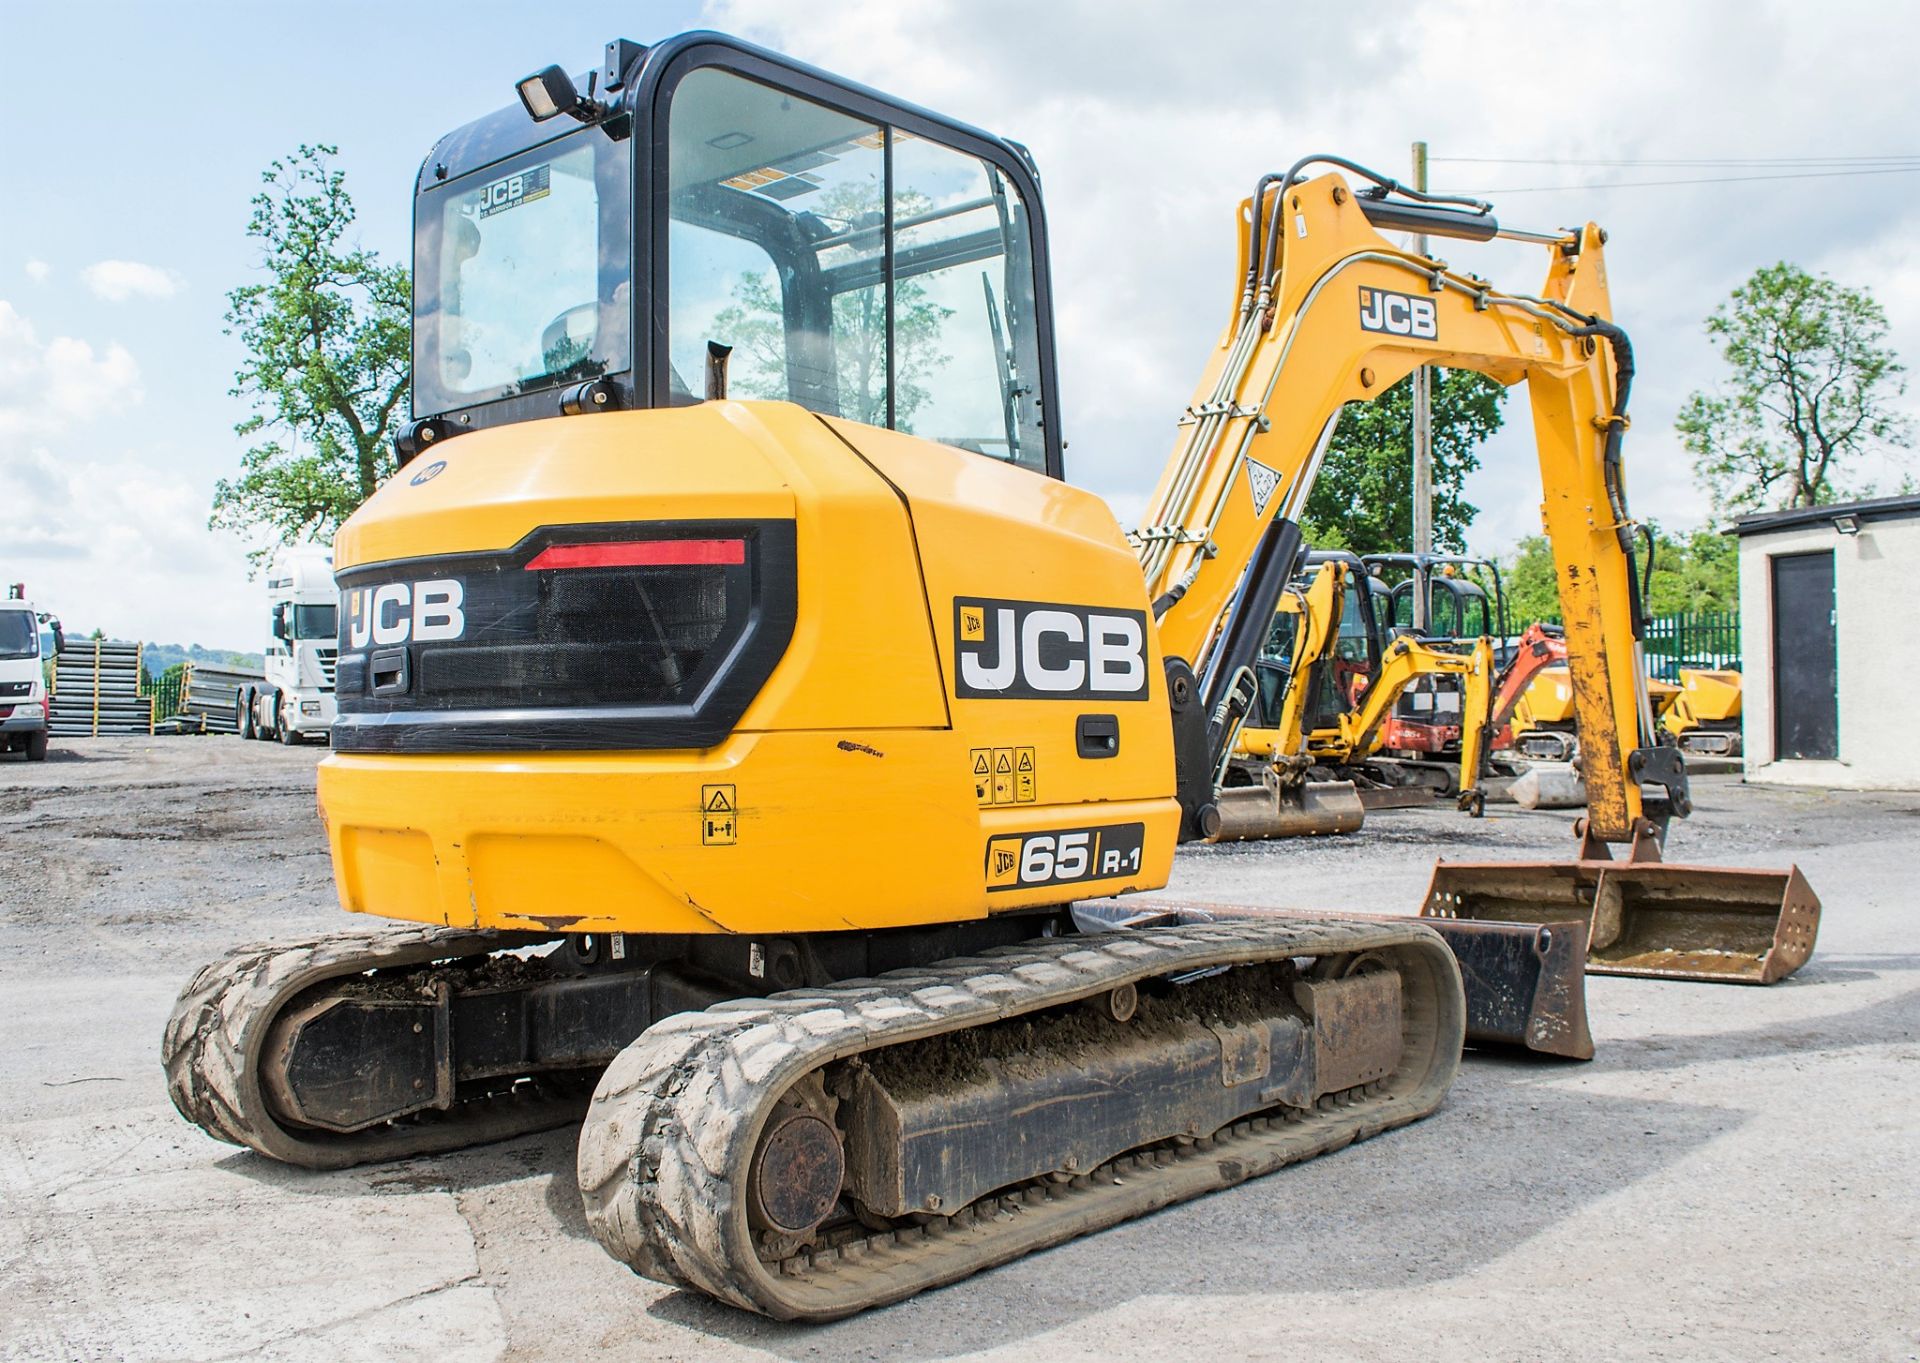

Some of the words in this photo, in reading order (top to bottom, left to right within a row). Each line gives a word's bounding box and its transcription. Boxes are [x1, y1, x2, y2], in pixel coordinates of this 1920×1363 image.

[481, 176, 523, 210] JCB
[1361, 291, 1437, 338] JCB
[351, 579, 465, 649] JCB
[966, 615, 981, 632] JCB
[960, 608, 1145, 692] JCB
[996, 851, 1015, 874] JCB
[1020, 831, 1090, 883] 65
[1103, 846, 1141, 875] R-1
